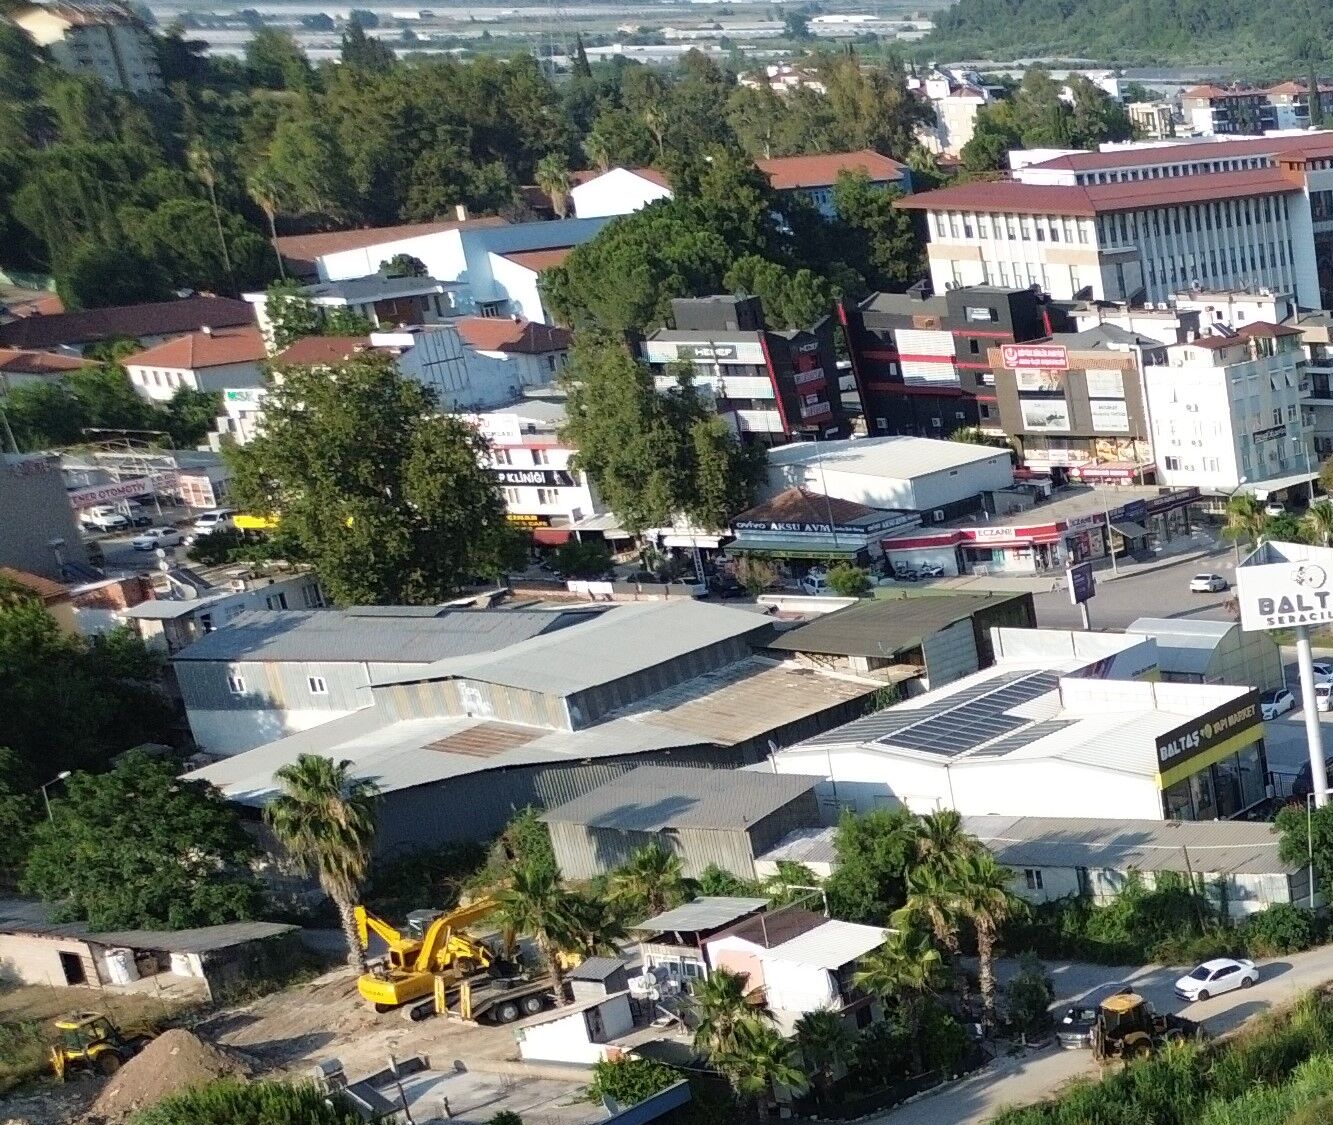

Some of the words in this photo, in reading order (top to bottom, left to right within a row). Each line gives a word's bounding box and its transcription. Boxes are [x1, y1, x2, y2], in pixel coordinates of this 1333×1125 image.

[506, 471, 546, 484] KLİNİĞİ
[770, 522, 801, 532] AKSU
[804, 523, 831, 533] AVM
[1159, 730, 1200, 761] BALTAŞ
